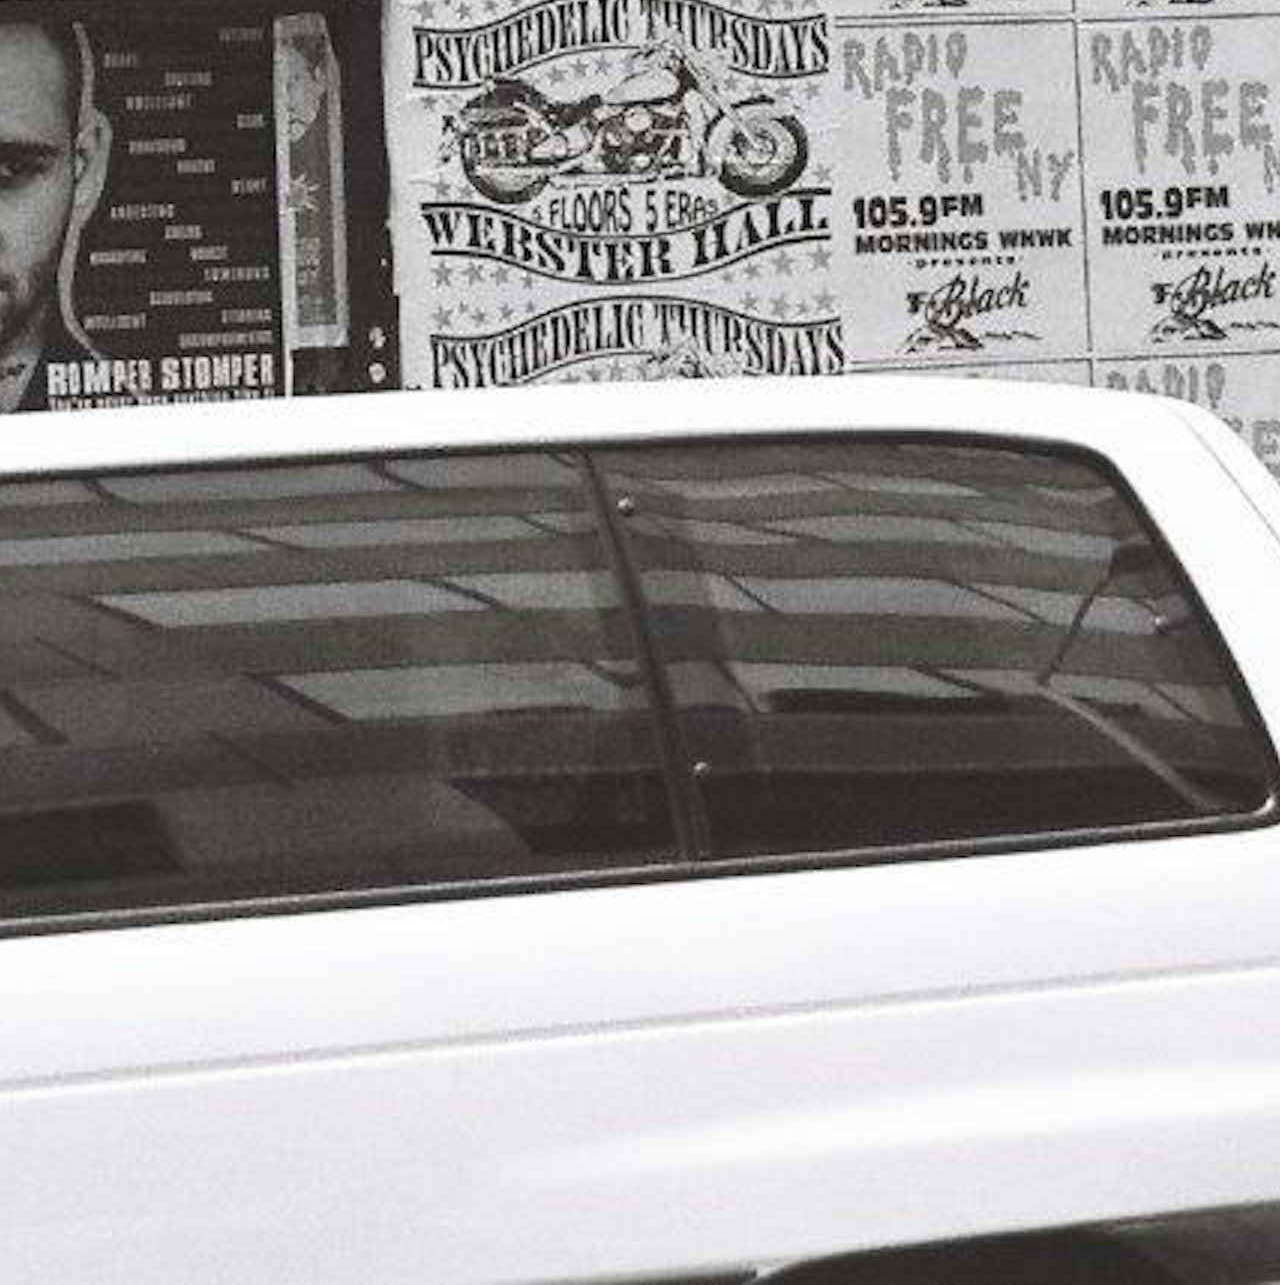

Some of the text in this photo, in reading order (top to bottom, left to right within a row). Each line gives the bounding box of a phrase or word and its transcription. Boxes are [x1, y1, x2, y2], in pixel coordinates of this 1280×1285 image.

[843, 31, 969, 101] RADIO
[1091, 25, 1213, 93] RADIO
[886, 85, 1027, 185] FREE
[1132, 78, 1274, 176] FREE
[549, 188, 631, 232] FLOORS
[646, 190, 658, 232] 5
[1017, 150, 1075, 202] NY
[422, 198, 829, 280] WEBSTER HALL
[855, 228, 1073, 255] MORNINGS WNWK
[1103, 223, 1234, 246] MORNINGS
[47, 354, 276, 395] ROMPER STOMPER
[431, 304, 846, 389] PSYCHEDELIC THURSDAYS
